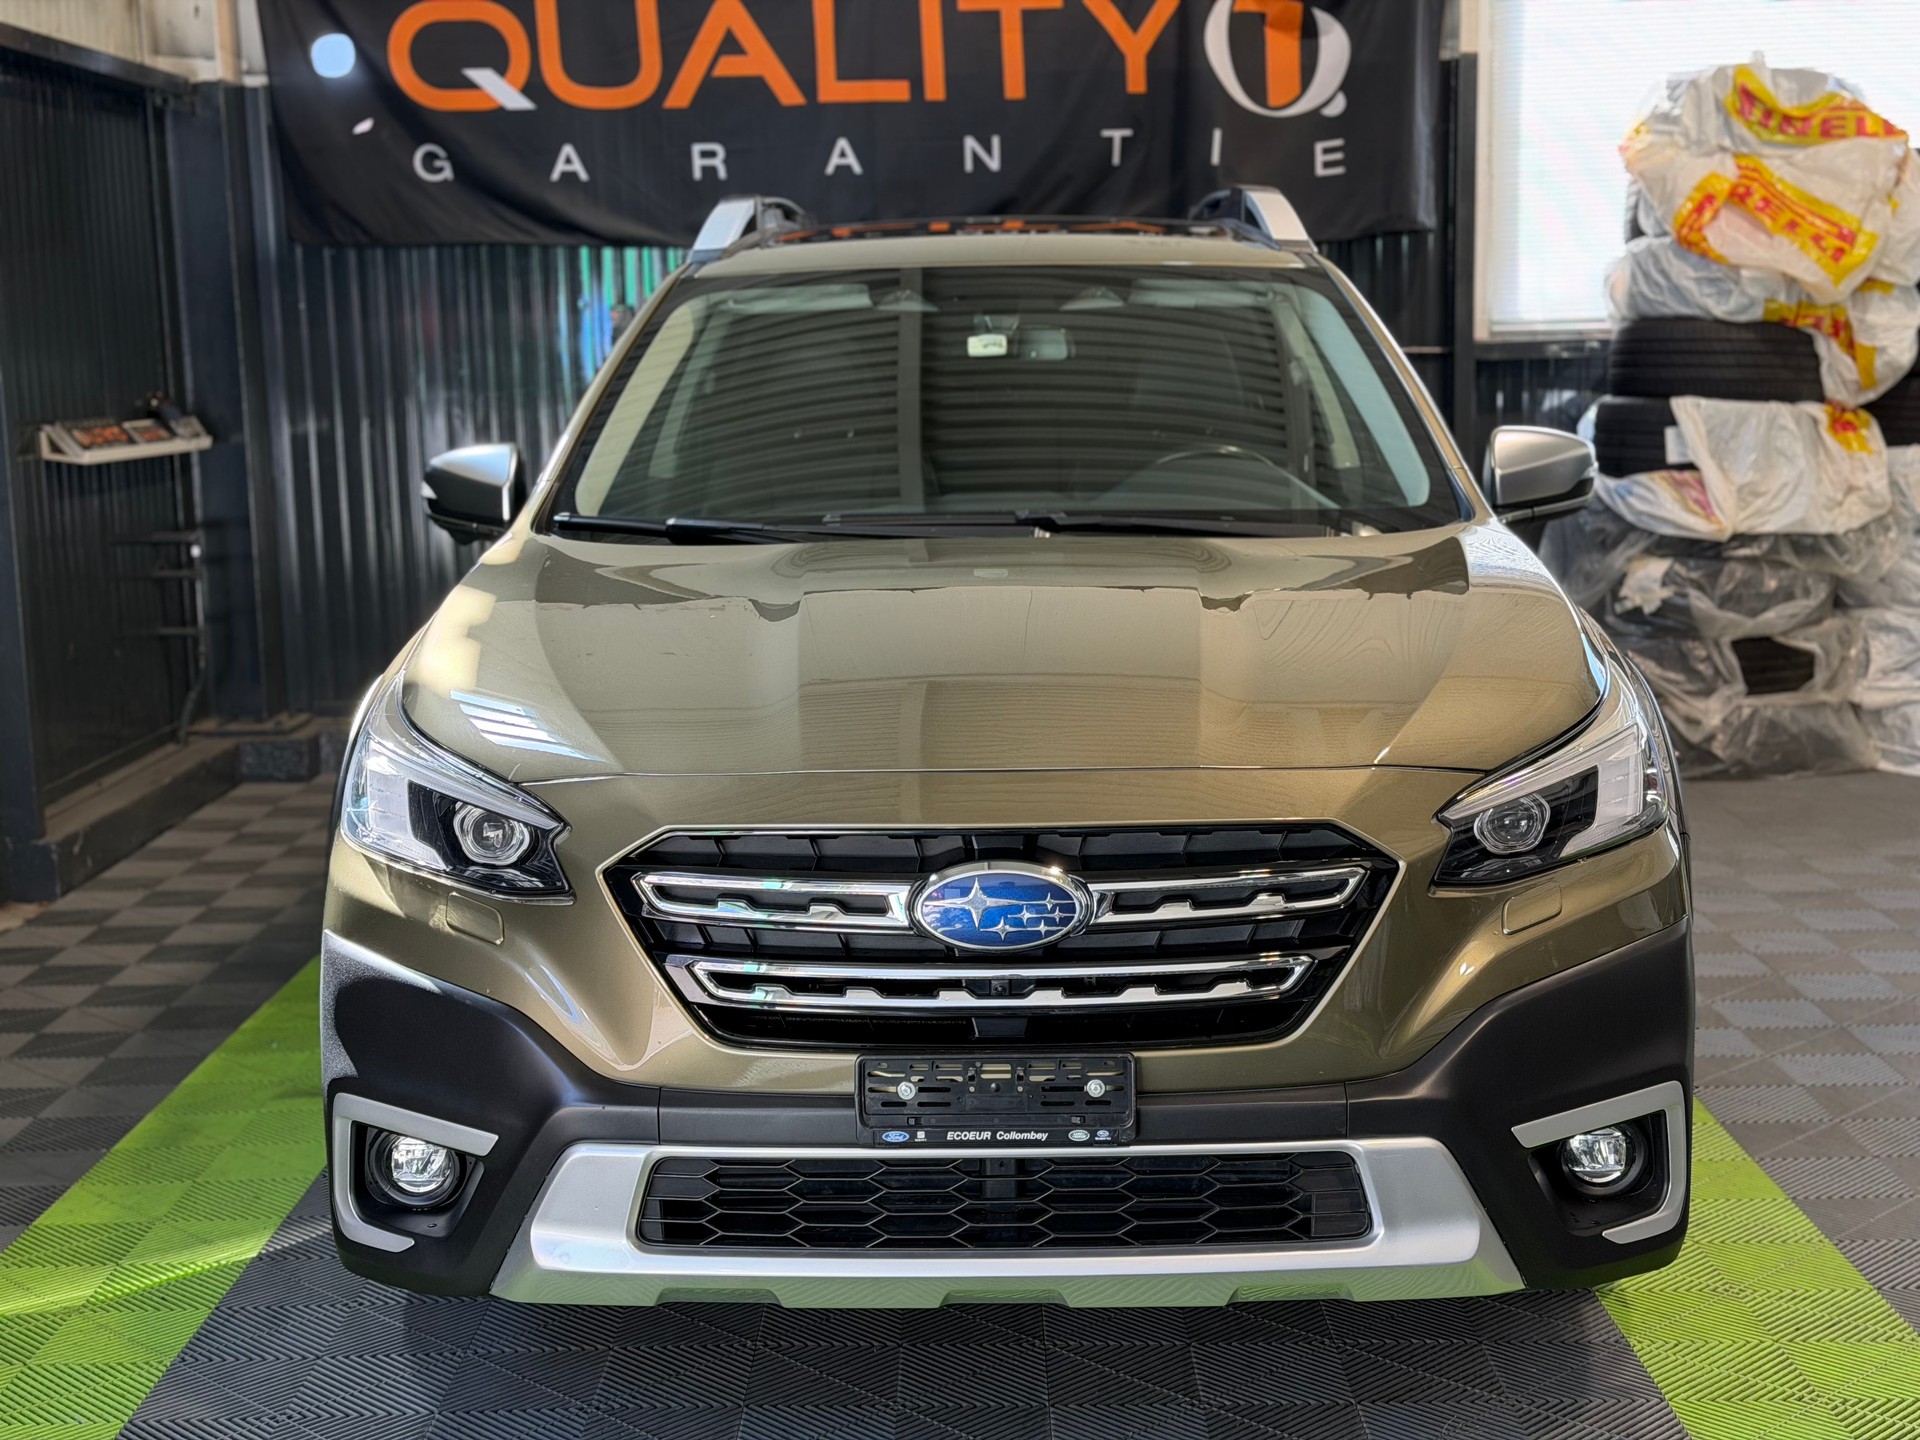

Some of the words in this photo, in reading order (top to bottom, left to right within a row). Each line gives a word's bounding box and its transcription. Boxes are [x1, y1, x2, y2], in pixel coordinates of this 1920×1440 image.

[387, 0, 1180, 111] QUALITY
[412, 127, 1347, 182] GARANTIE
[946, 1131, 992, 1141] ECOEUR
[996, 1130, 1049, 1142] Collombey
